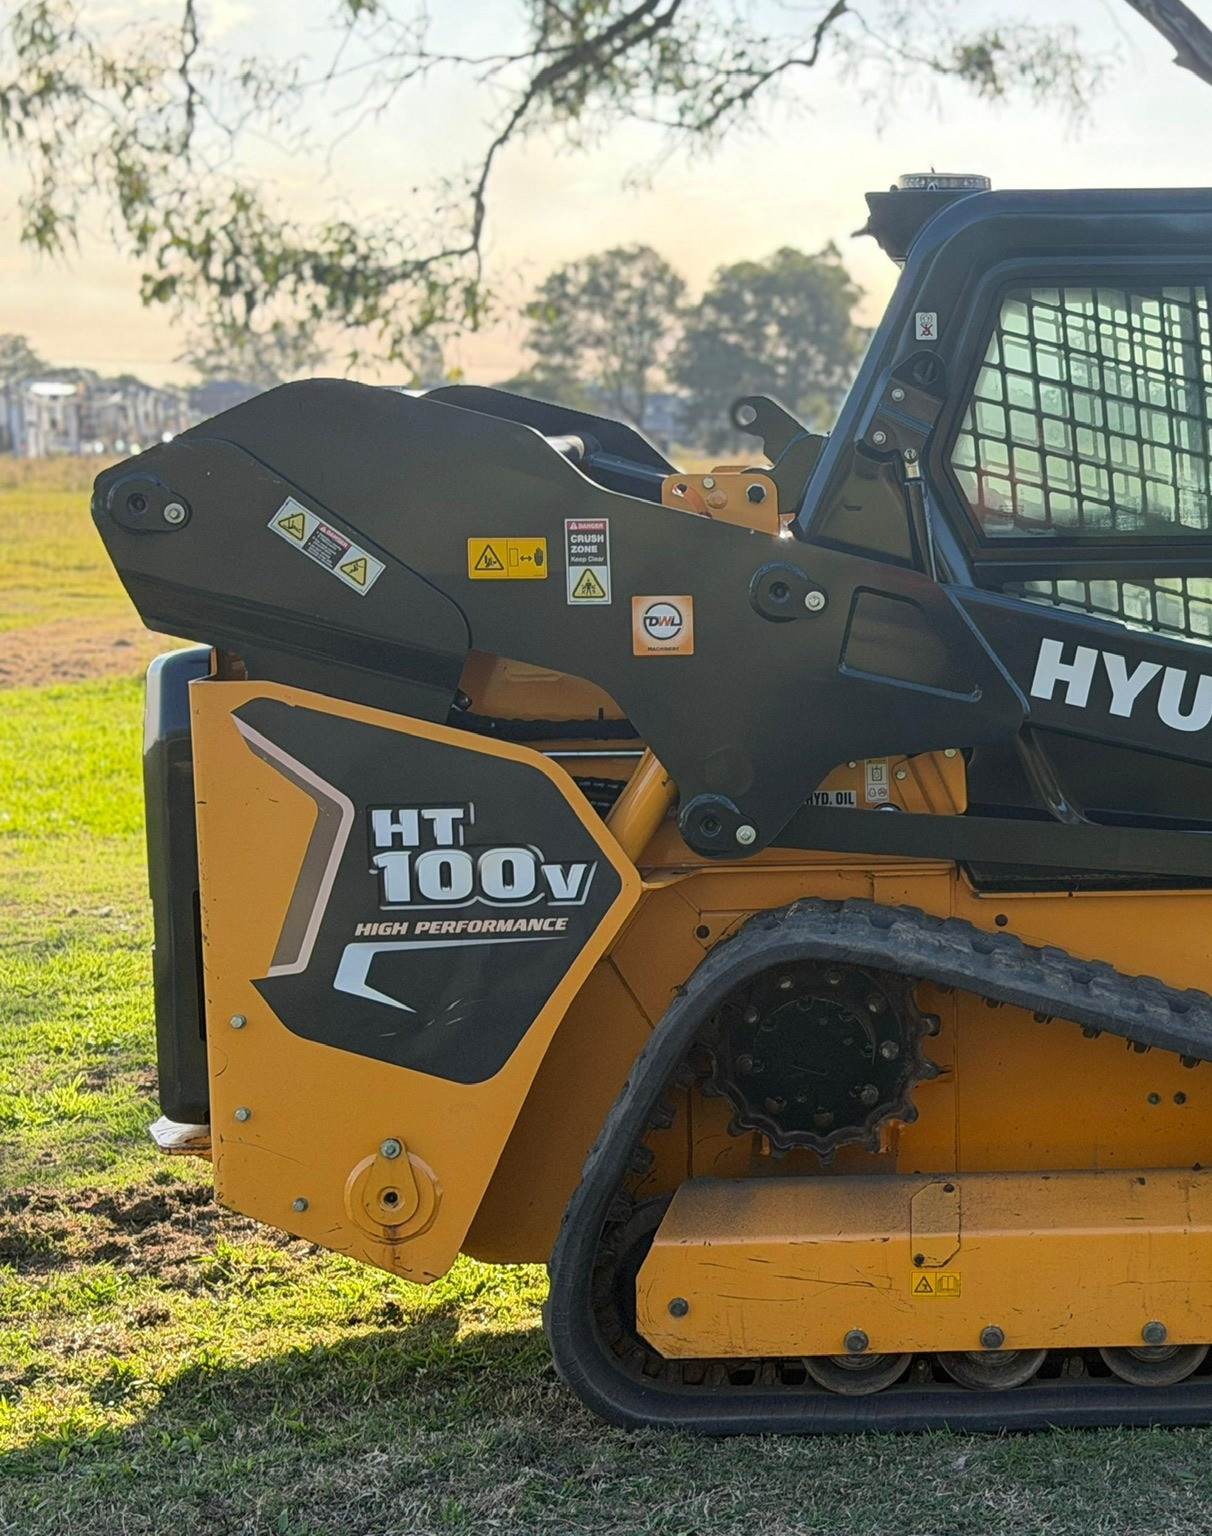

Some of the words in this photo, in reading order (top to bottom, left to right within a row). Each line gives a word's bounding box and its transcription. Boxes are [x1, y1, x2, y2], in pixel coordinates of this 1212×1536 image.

[578, 522, 605, 530] DANGER
[570, 534, 605, 543] CRUSH
[570, 545, 598, 553] ZONE
[643, 615, 683, 627] DWL
[836, 792, 855, 805] OIL
[371, 808, 465, 848] HT
[355, 922, 409, 937] HIGH
[414, 917, 569, 935] PERFORMANCE
